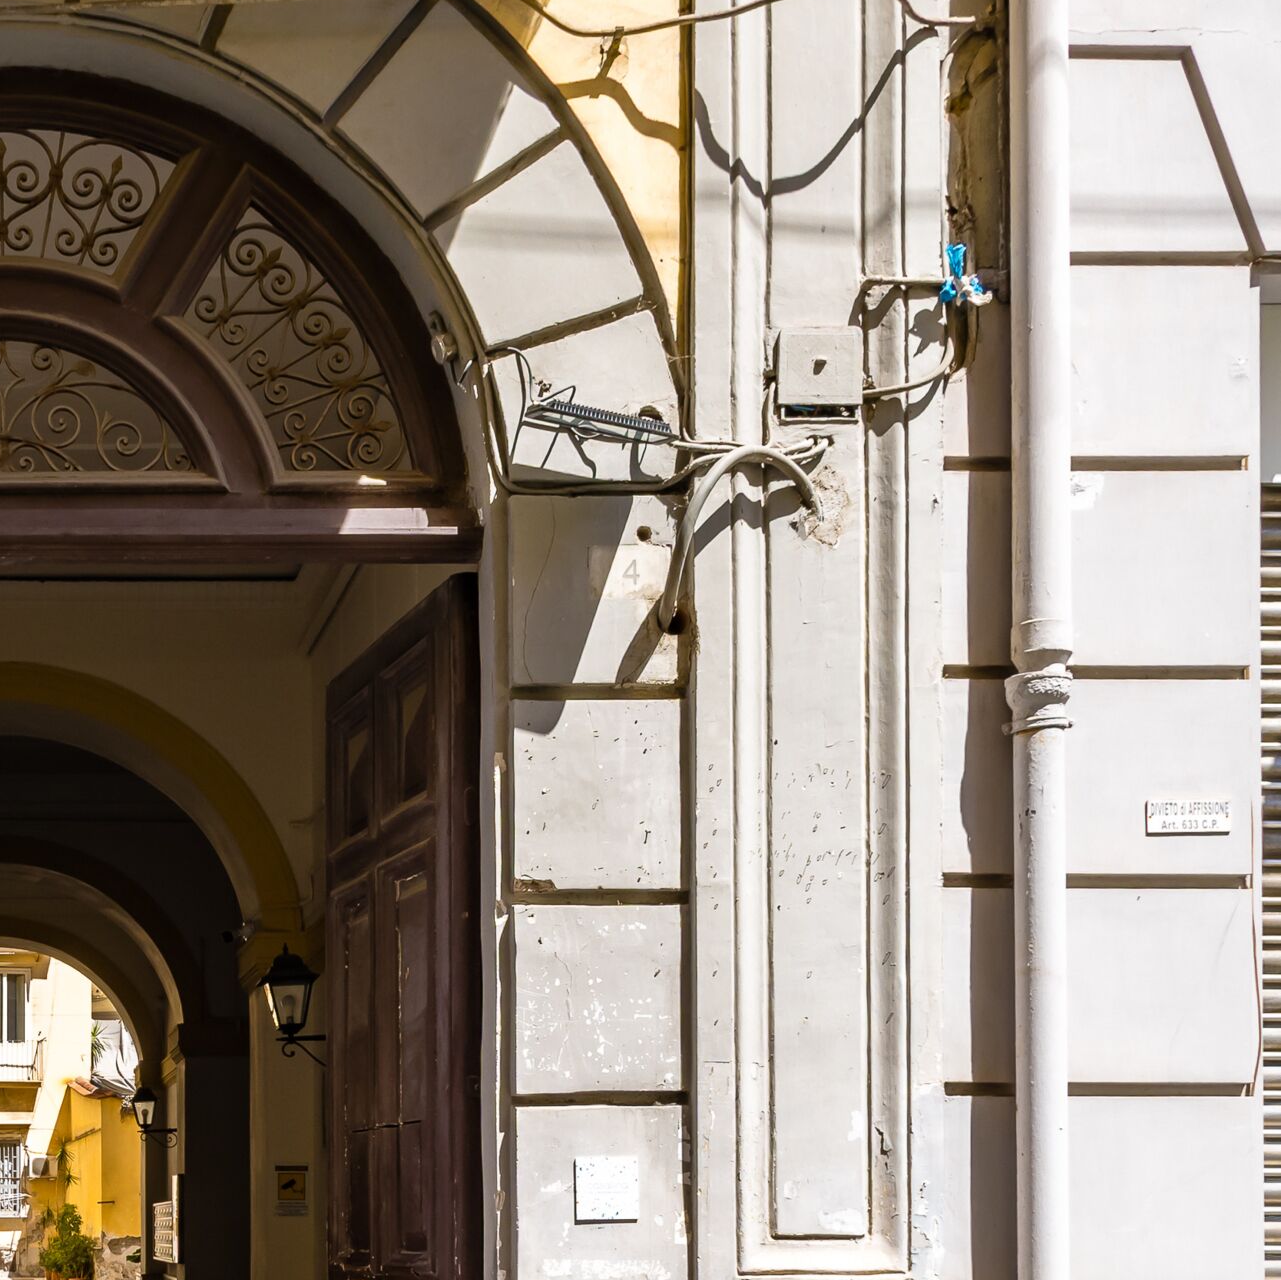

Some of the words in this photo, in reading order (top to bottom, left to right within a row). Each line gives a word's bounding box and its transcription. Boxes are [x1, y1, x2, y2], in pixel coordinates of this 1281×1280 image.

[622, 559, 640, 585] 4
[1150, 801, 1178, 817] DIVIETO
[1188, 801, 1229, 816] AFFISSIONE
[1161, 820, 1179, 830] Art.
[1182, 819, 1199, 829] 633
